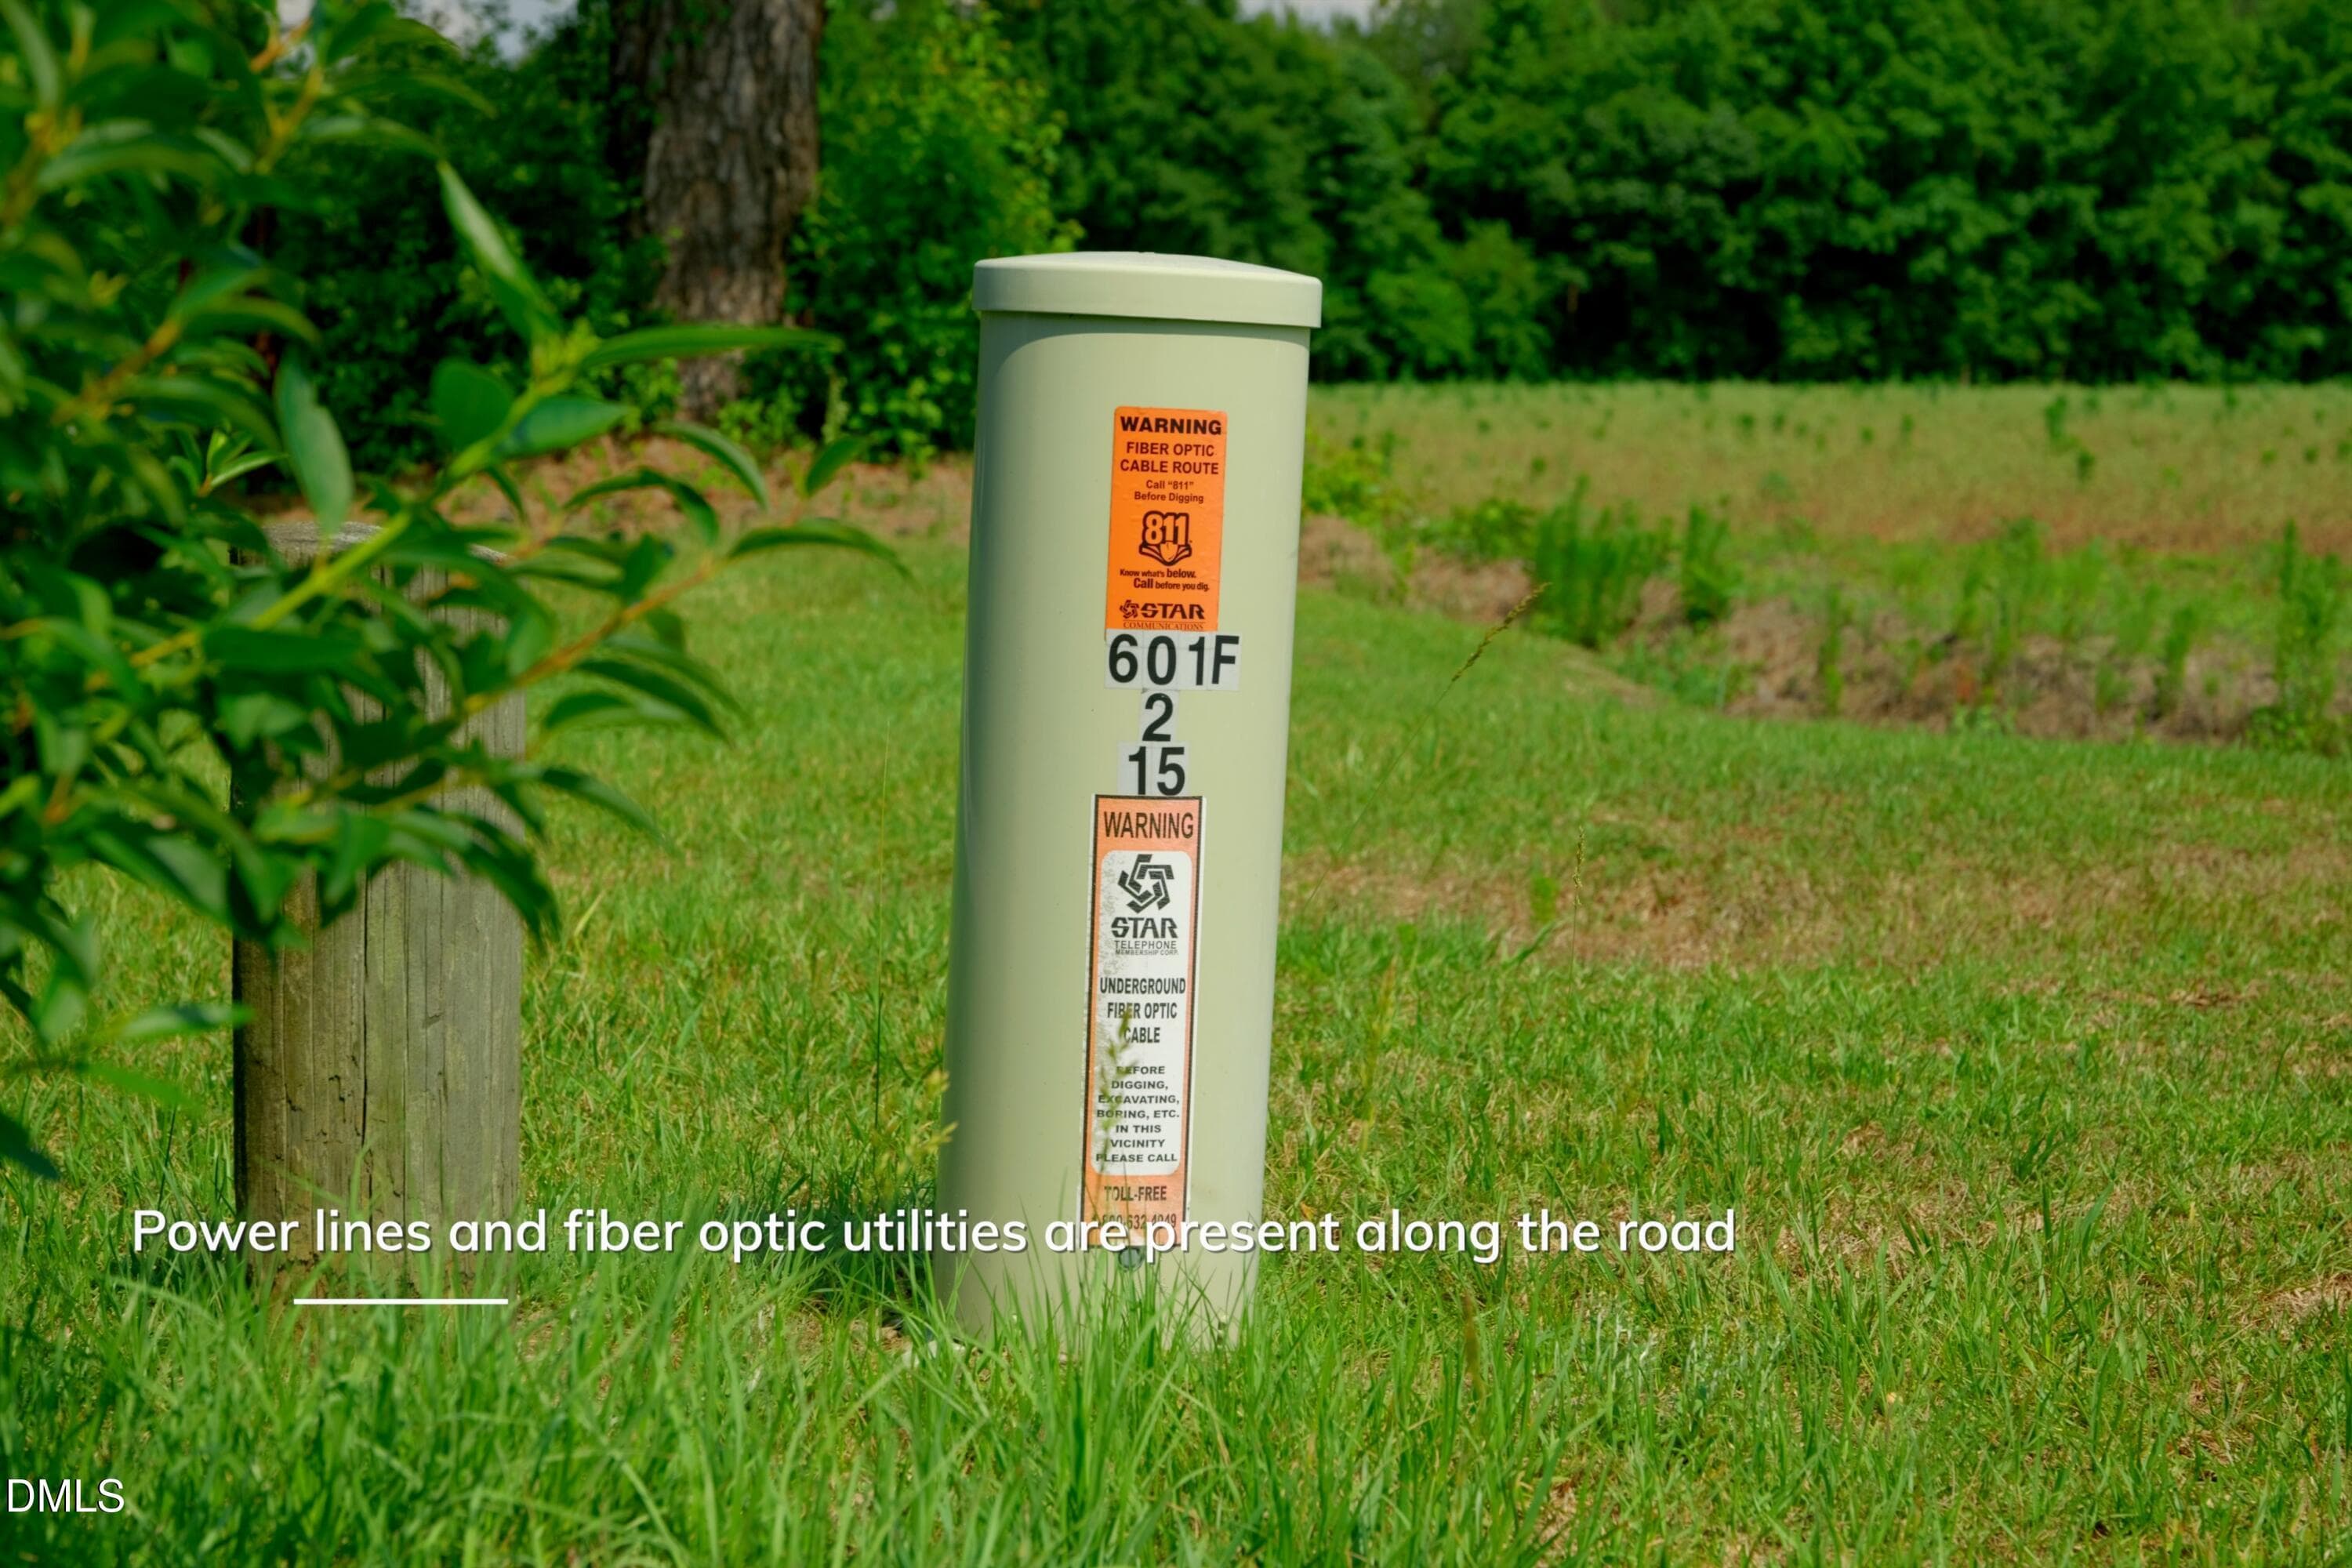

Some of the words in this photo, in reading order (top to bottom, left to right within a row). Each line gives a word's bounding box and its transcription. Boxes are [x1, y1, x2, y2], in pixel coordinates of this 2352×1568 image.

[1120, 416, 1221, 435] WARNING
[1127, 441, 1168, 455] FIBER
[1173, 444, 1214, 456] OPTIC
[1120, 459, 1168, 473] CABLE
[1173, 462, 1218, 474] ROUTE
[1146, 480, 1165, 489] Call
[1134, 492, 1166, 501] Before
[1169, 493, 1204, 504] Digging
[1142, 510, 1189, 546] 811
[1167, 568, 1196, 578] below.
[1134, 578, 1153, 589] Call
[1155, 581, 1181, 590] before
[1196, 583, 1210, 592] dig.
[1141, 603, 1205, 619] STAR
[1123, 622, 1204, 631] COMMUNICATIONS
[1109, 633, 1240, 685] 601F
[1142, 693, 1174, 742] 2
[1128, 746, 1185, 796] 15
[1104, 811, 1194, 839] WARNING
[1111, 916, 1178, 938] STAR
[1114, 940, 1177, 949] TELEPHONE
[1100, 978, 1186, 994] UNDERGROUND
[1107, 1002, 1141, 1019] FIBER
[1145, 1003, 1178, 1019] OPTIC
[1123, 1027, 1160, 1044] CABLE
[1112, 1081, 1168, 1091] DIGGING,
[1110, 1139, 1166, 1148] VICINITY
[1096, 1153, 1144, 1162] PLEASE
[1147, 1153, 1178, 1162] CALL
[1104, 1185, 1167, 1201] TOLL-FREE
